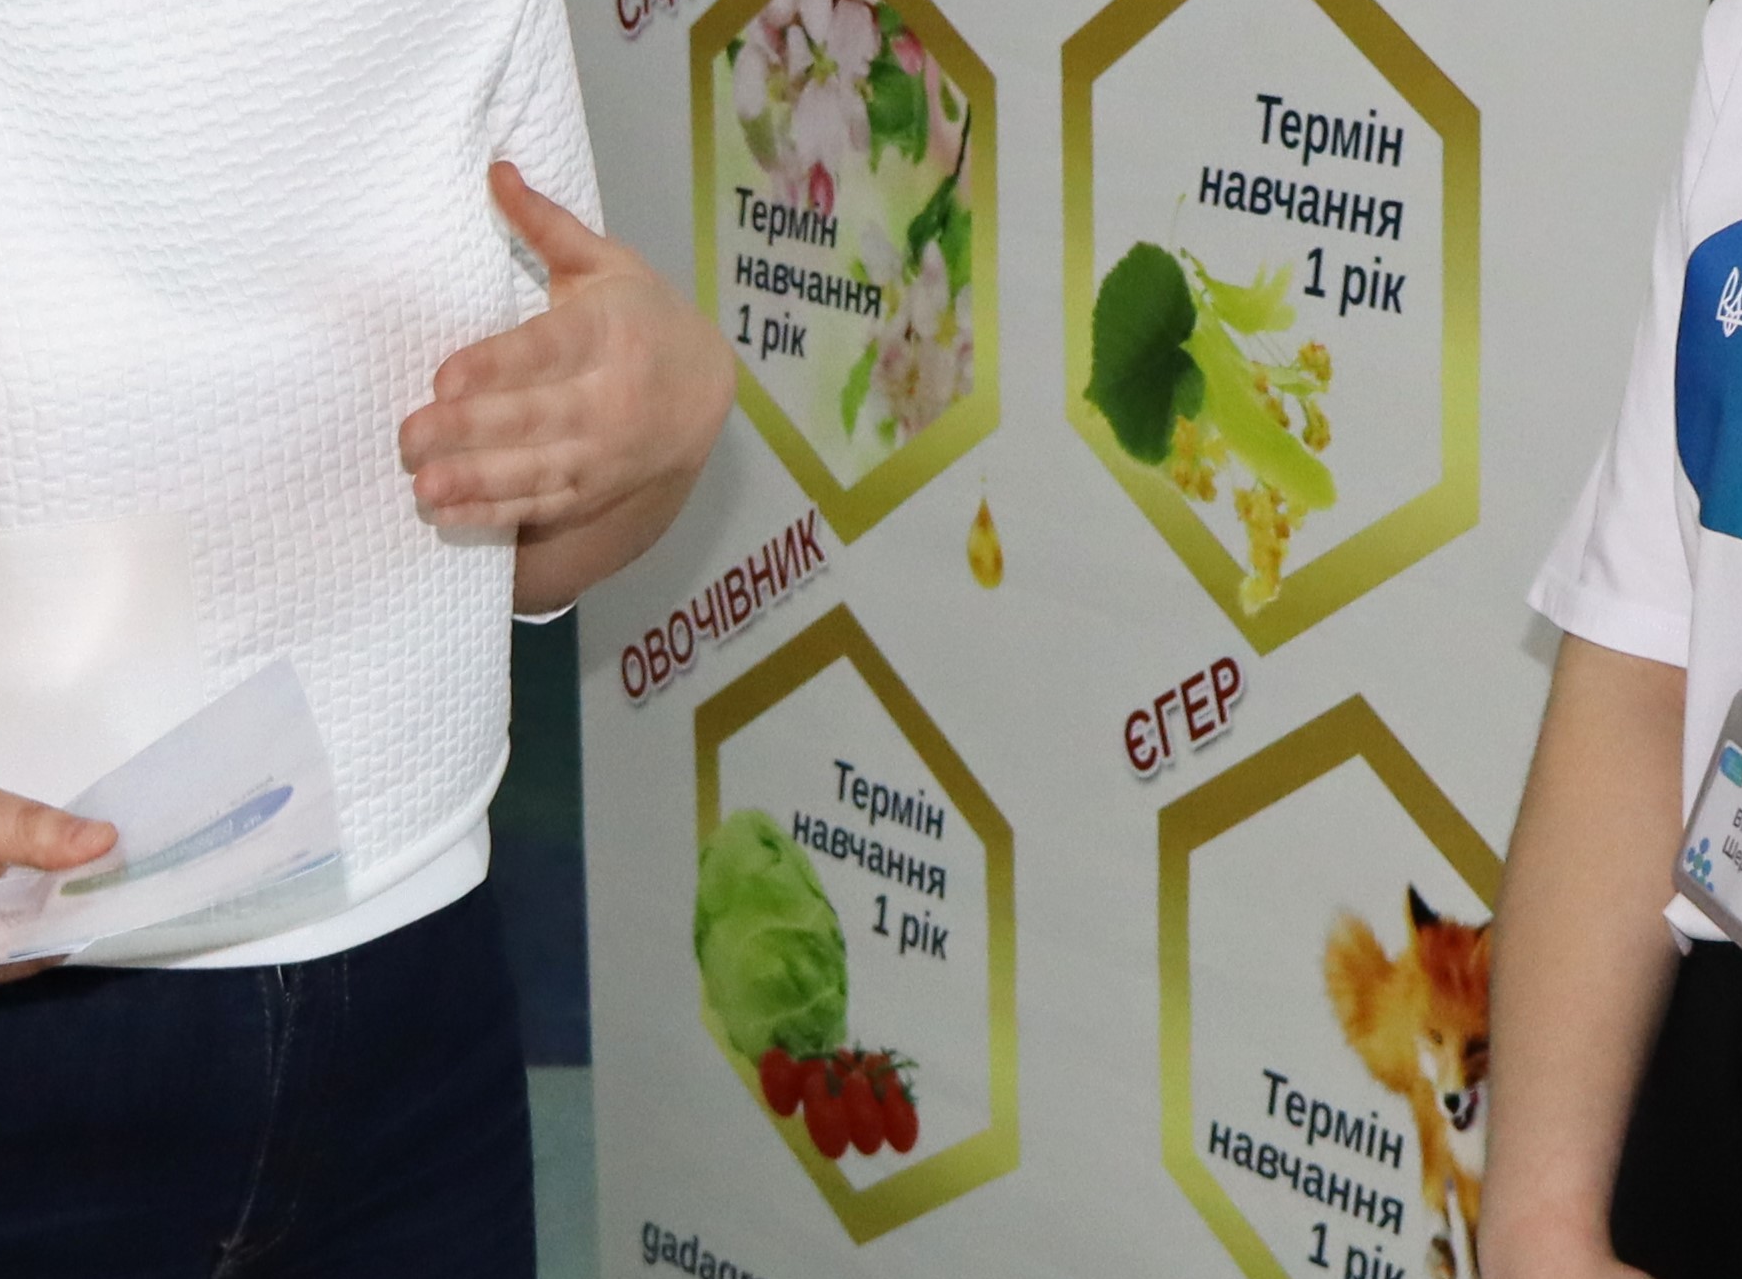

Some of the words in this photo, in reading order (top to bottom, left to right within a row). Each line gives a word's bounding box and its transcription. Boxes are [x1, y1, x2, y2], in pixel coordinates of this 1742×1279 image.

[1256, 94, 1405, 168] Термін
[734, 187, 838, 249] Термін
[1198, 166, 1404, 241] навчання
[735, 253, 882, 319] навчання
[1304, 247, 1326, 298] 1
[1339, 257, 1406, 318] рік
[736, 303, 753, 345] 1
[762, 311, 808, 360] рік
[621, 509, 826, 700] ОВОЧІВНИК
[1124, 656, 1242, 772] ЄГЕР
[834, 759, 945, 840] Термін
[793, 811, 947, 899] навчання
[872, 894, 890, 937] 1
[900, 910, 949, 961] рік
[1263, 1067, 1404, 1169] Термін
[1209, 1120, 1404, 1235] навчання
[1307, 1221, 1330, 1268] 1
